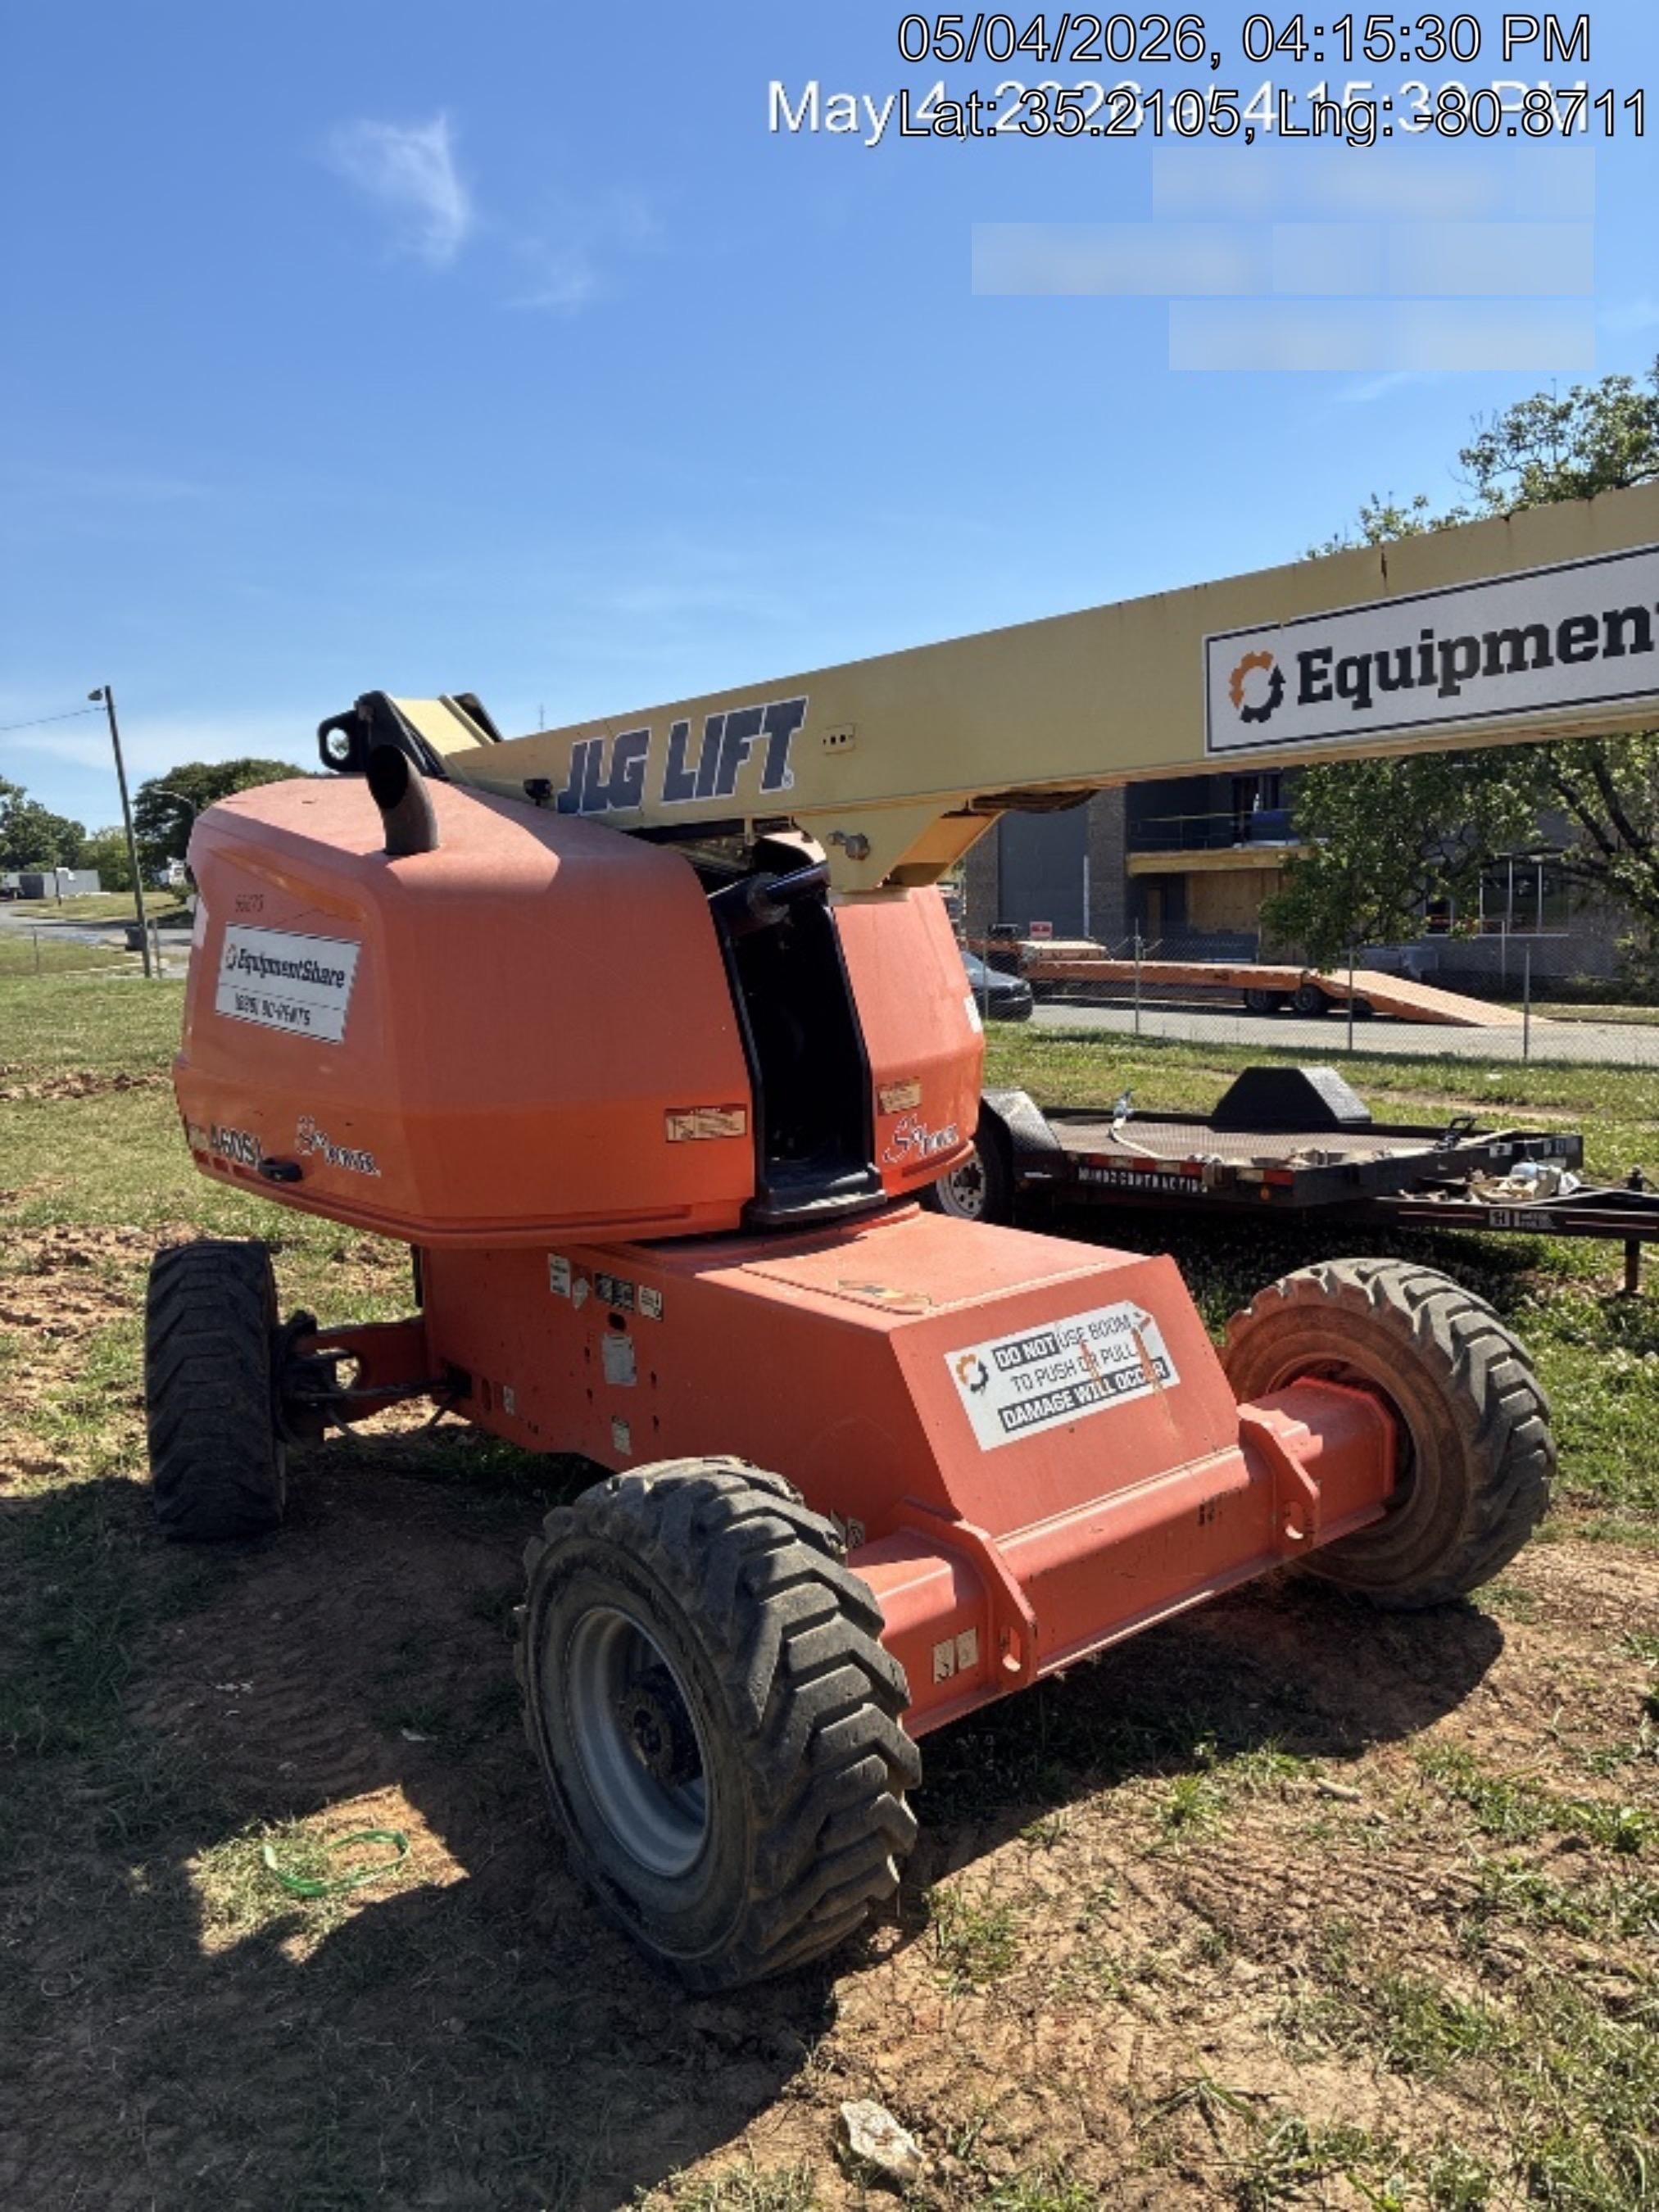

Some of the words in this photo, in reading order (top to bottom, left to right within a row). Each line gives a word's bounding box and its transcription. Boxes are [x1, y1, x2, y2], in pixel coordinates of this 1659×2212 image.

[1296, 600, 1659, 710] Equipmen
[557, 727, 651, 816] JLG
[660, 696, 809, 806] LIFT
[238, 948, 345, 988] EquipmentShare
[995, 1346, 1022, 1368] DO
[1023, 1336, 1058, 1359] NOT
[1058, 1327, 1088, 1349] USE
[1089, 1314, 1131, 1339] BOOM
[1011, 1374, 1033, 1392] TO
[1034, 1359, 1077, 1386] PUSH
[1099, 1344, 1138, 1365] PULL
[1002, 1389, 1075, 1429] DAMAGE
[1073, 1377, 1117, 1403] WILL
[1115, 1360, 1167, 1389] OCCR
